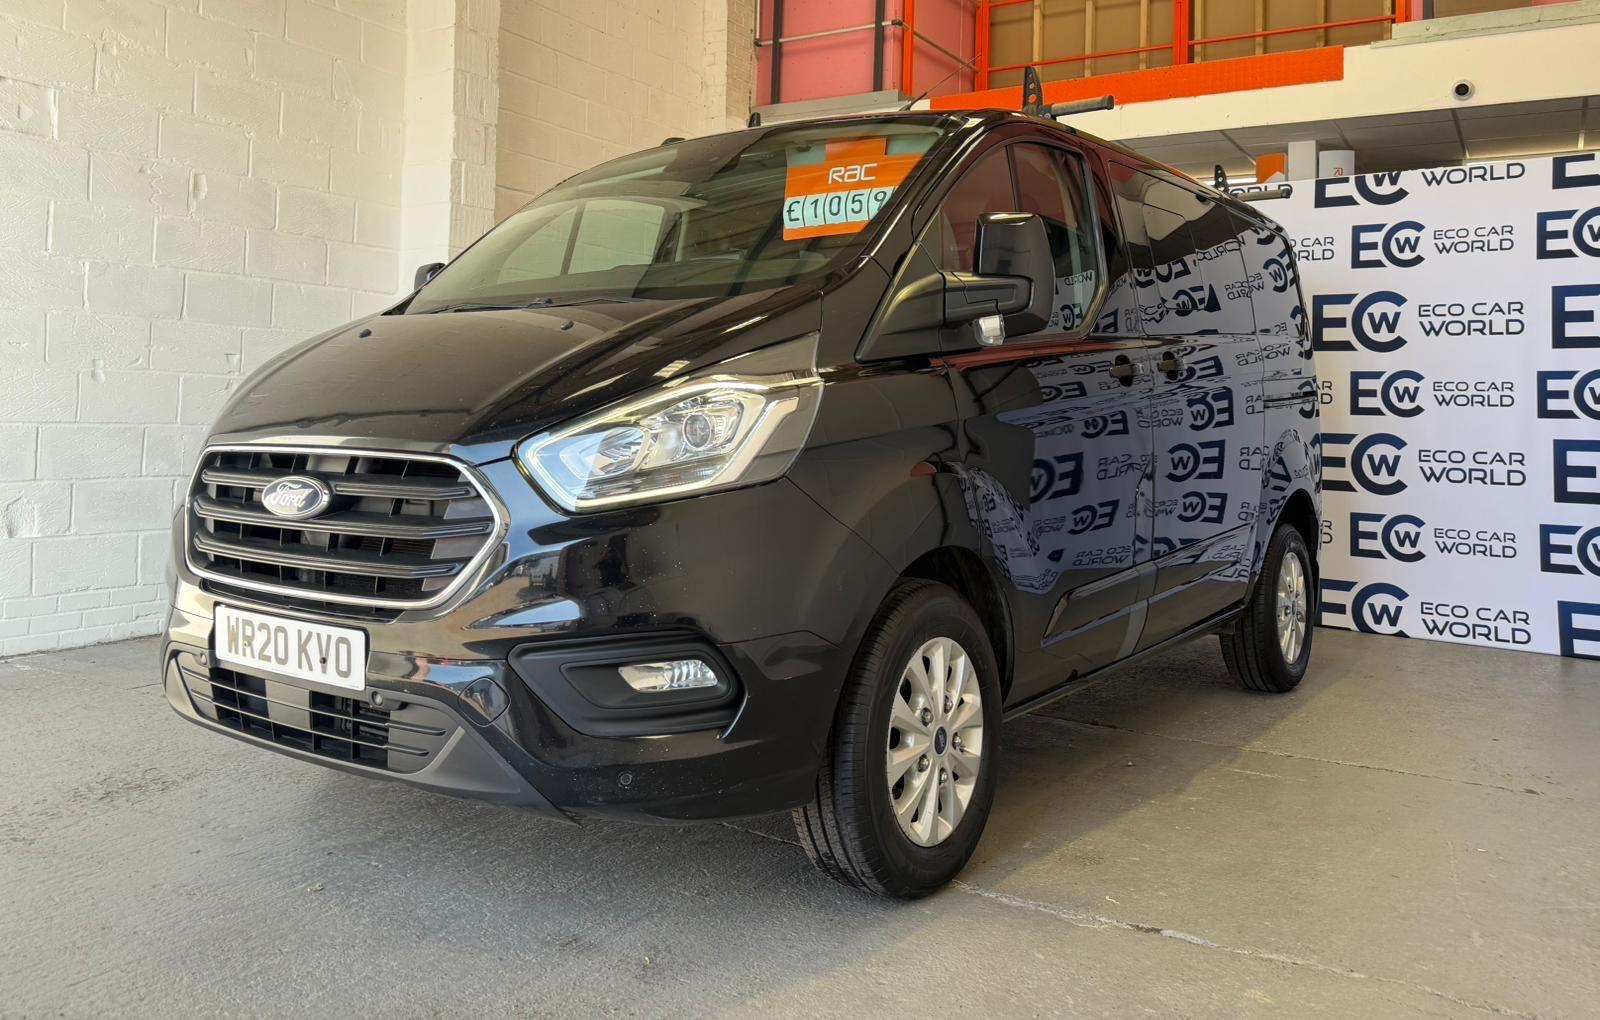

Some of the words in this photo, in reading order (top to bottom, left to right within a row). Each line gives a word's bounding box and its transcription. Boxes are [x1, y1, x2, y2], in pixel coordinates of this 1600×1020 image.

[1422, 162, 1526, 187] WORLD
[1433, 228, 1467, 240] ECO
[1474, 224, 1514, 238] CAR
[1301, 236, 1335, 248] CAR
[1434, 238, 1515, 255] WORLD
[1418, 303, 1465, 318] ECO
[1471, 301, 1525, 316] CAR
[1418, 319, 1525, 337] WORLD
[1432, 381, 1468, 392] ECO
[1473, 381, 1514, 392] CAR
[1433, 393, 1515, 408] WORLD
[1418, 449, 1465, 464] ECO
[1472, 451, 1526, 467] CAR
[1419, 465, 1527, 487] WORLD
[267, 482, 314, 508] Ford
[1433, 527, 1470, 541] ECO
[1475, 530, 1517, 544] CAR
[1434, 541, 1518, 559] WORLD
[1420, 601, 1468, 619] ECO
[1475, 607, 1530, 626] CAR
[1421, 618, 1532, 645] WORLD
[226, 615, 290, 666] WR20
[296, 629, 352, 679] KVO
